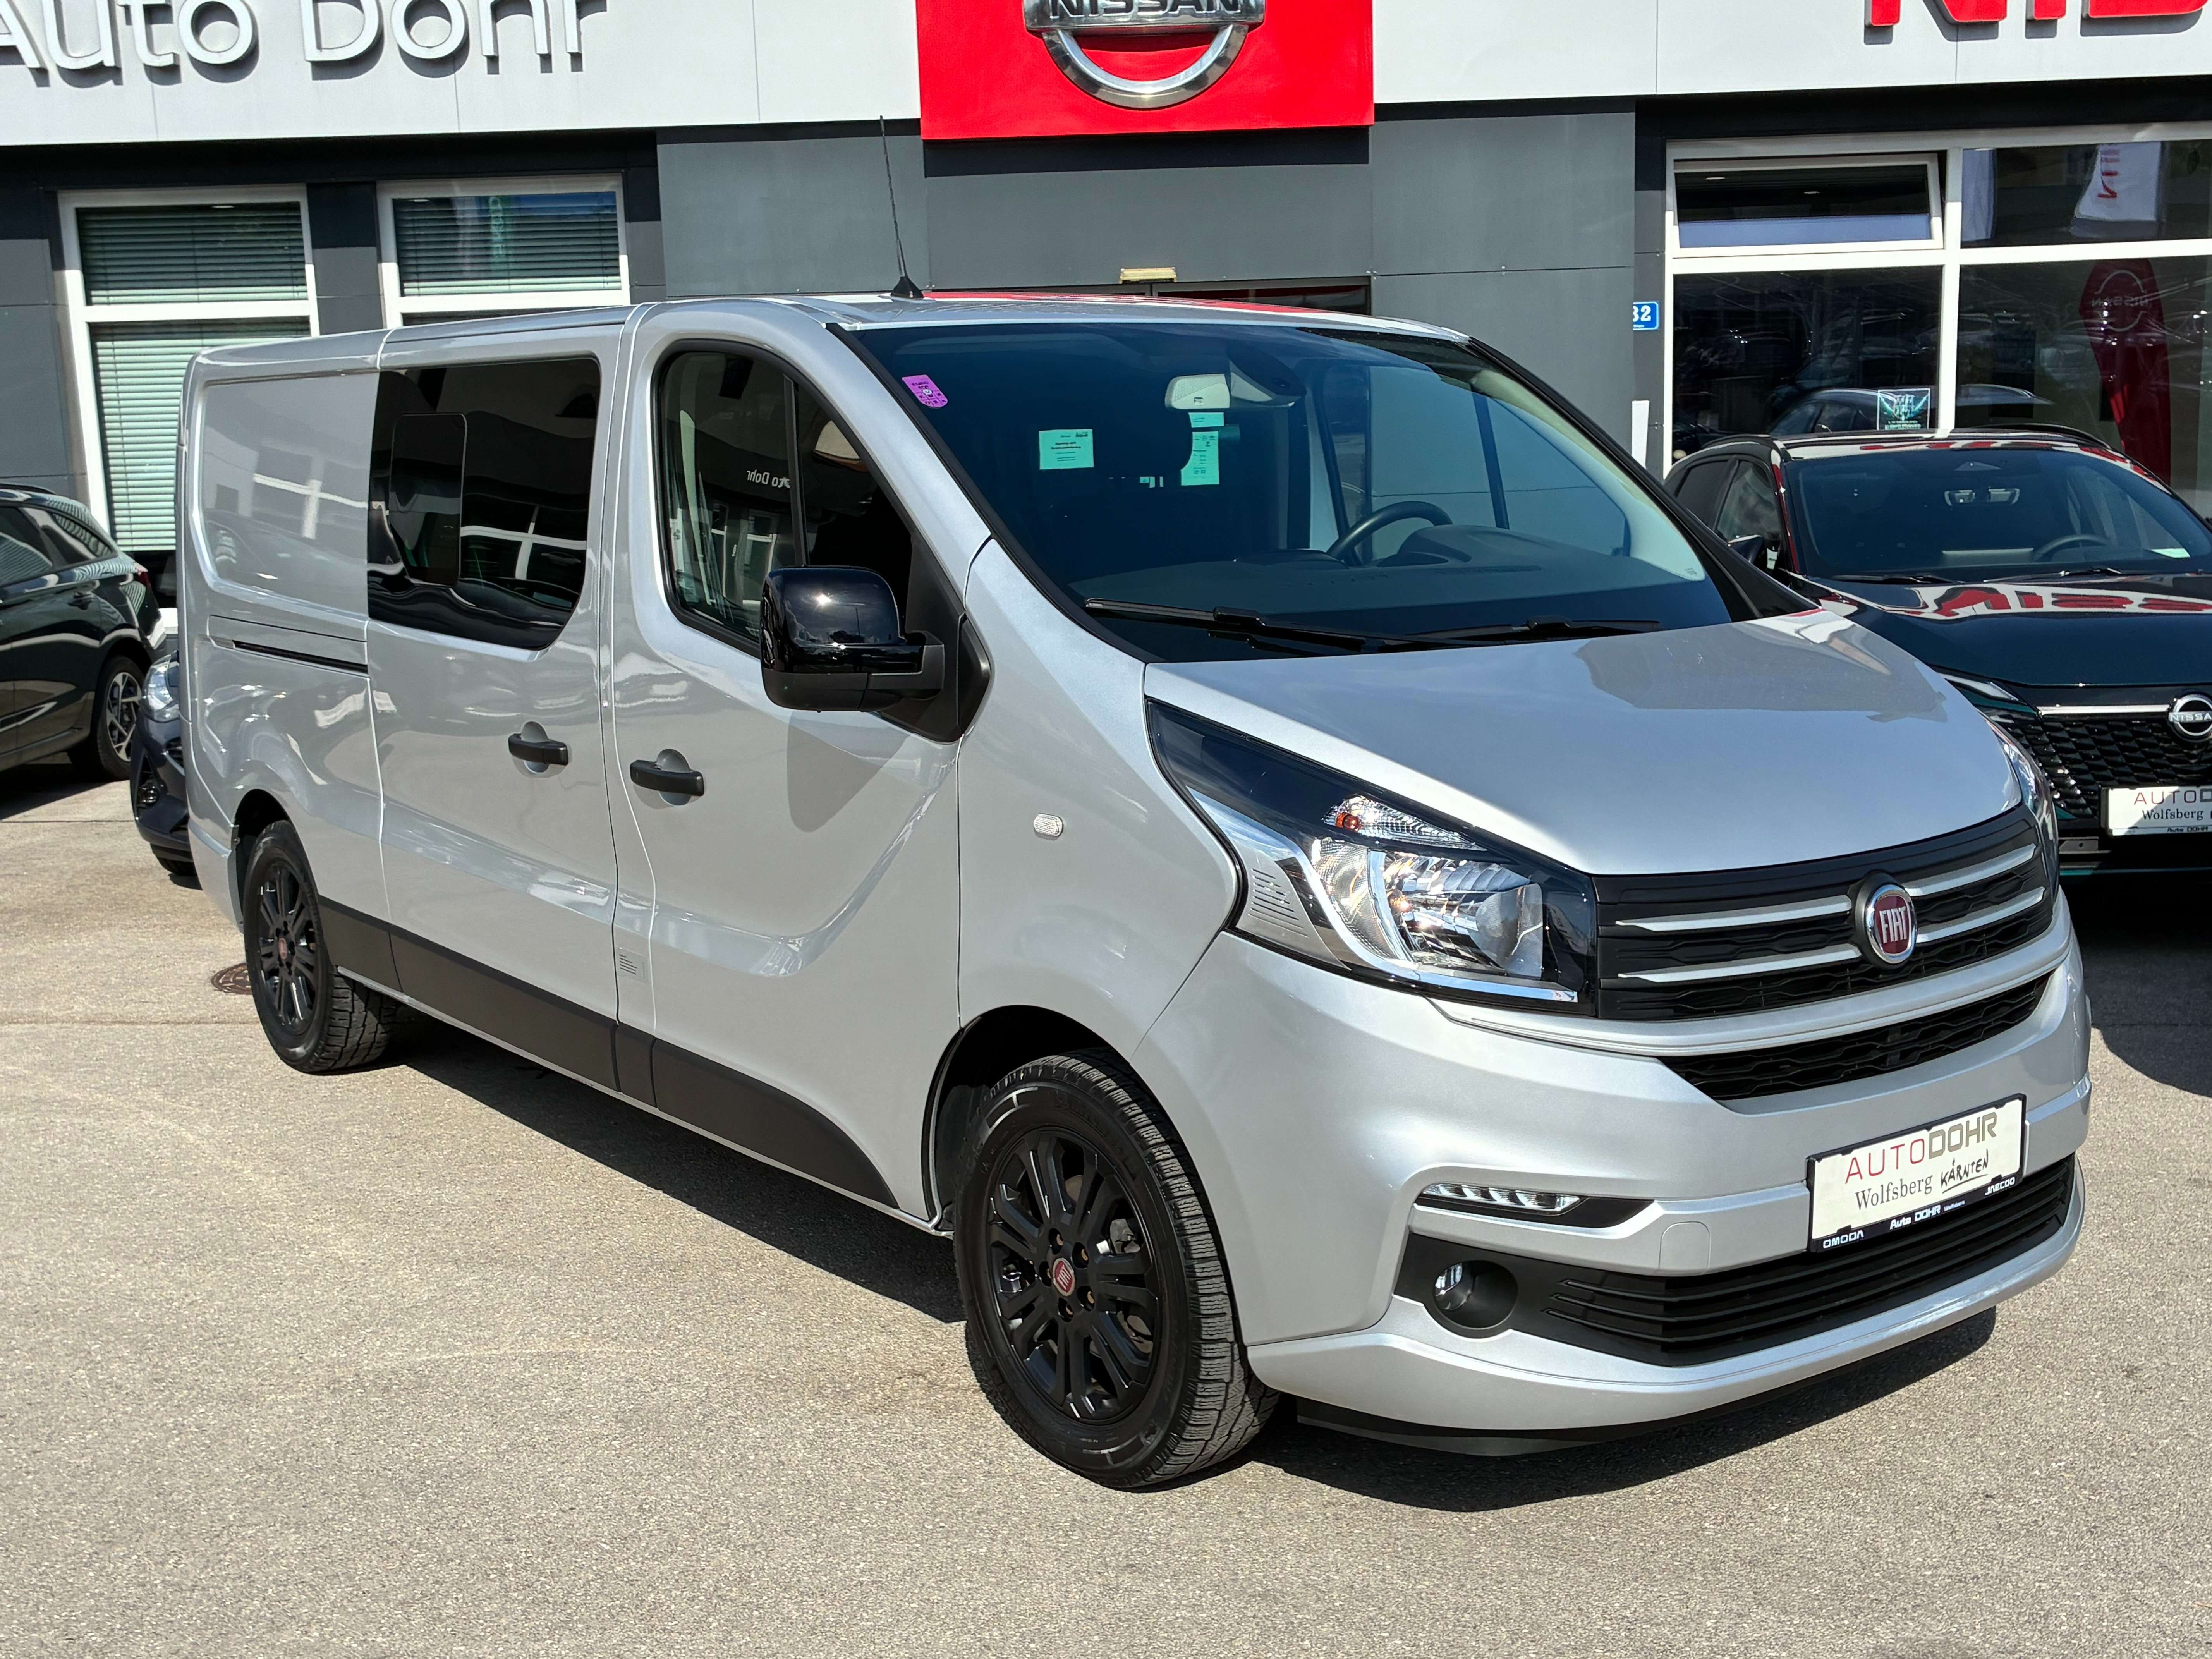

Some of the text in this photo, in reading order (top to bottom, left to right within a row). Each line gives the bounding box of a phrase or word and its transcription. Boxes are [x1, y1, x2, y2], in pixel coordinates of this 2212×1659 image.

[0, 0, 254, 69] uto
[2142, 808, 2204, 821] Wolfsberg
[1879, 906, 1907, 943] FIAT
[1854, 1175, 1934, 1211] Wolfsberg
[1984, 1176, 2015, 1196] JAECOO
[1889, 1216, 1912, 1230] Auto
[1914, 1204, 1941, 1222] DOHR
[1822, 1229, 1864, 1249] OMODA
[1057, 1264, 1072, 1290] FIAT
